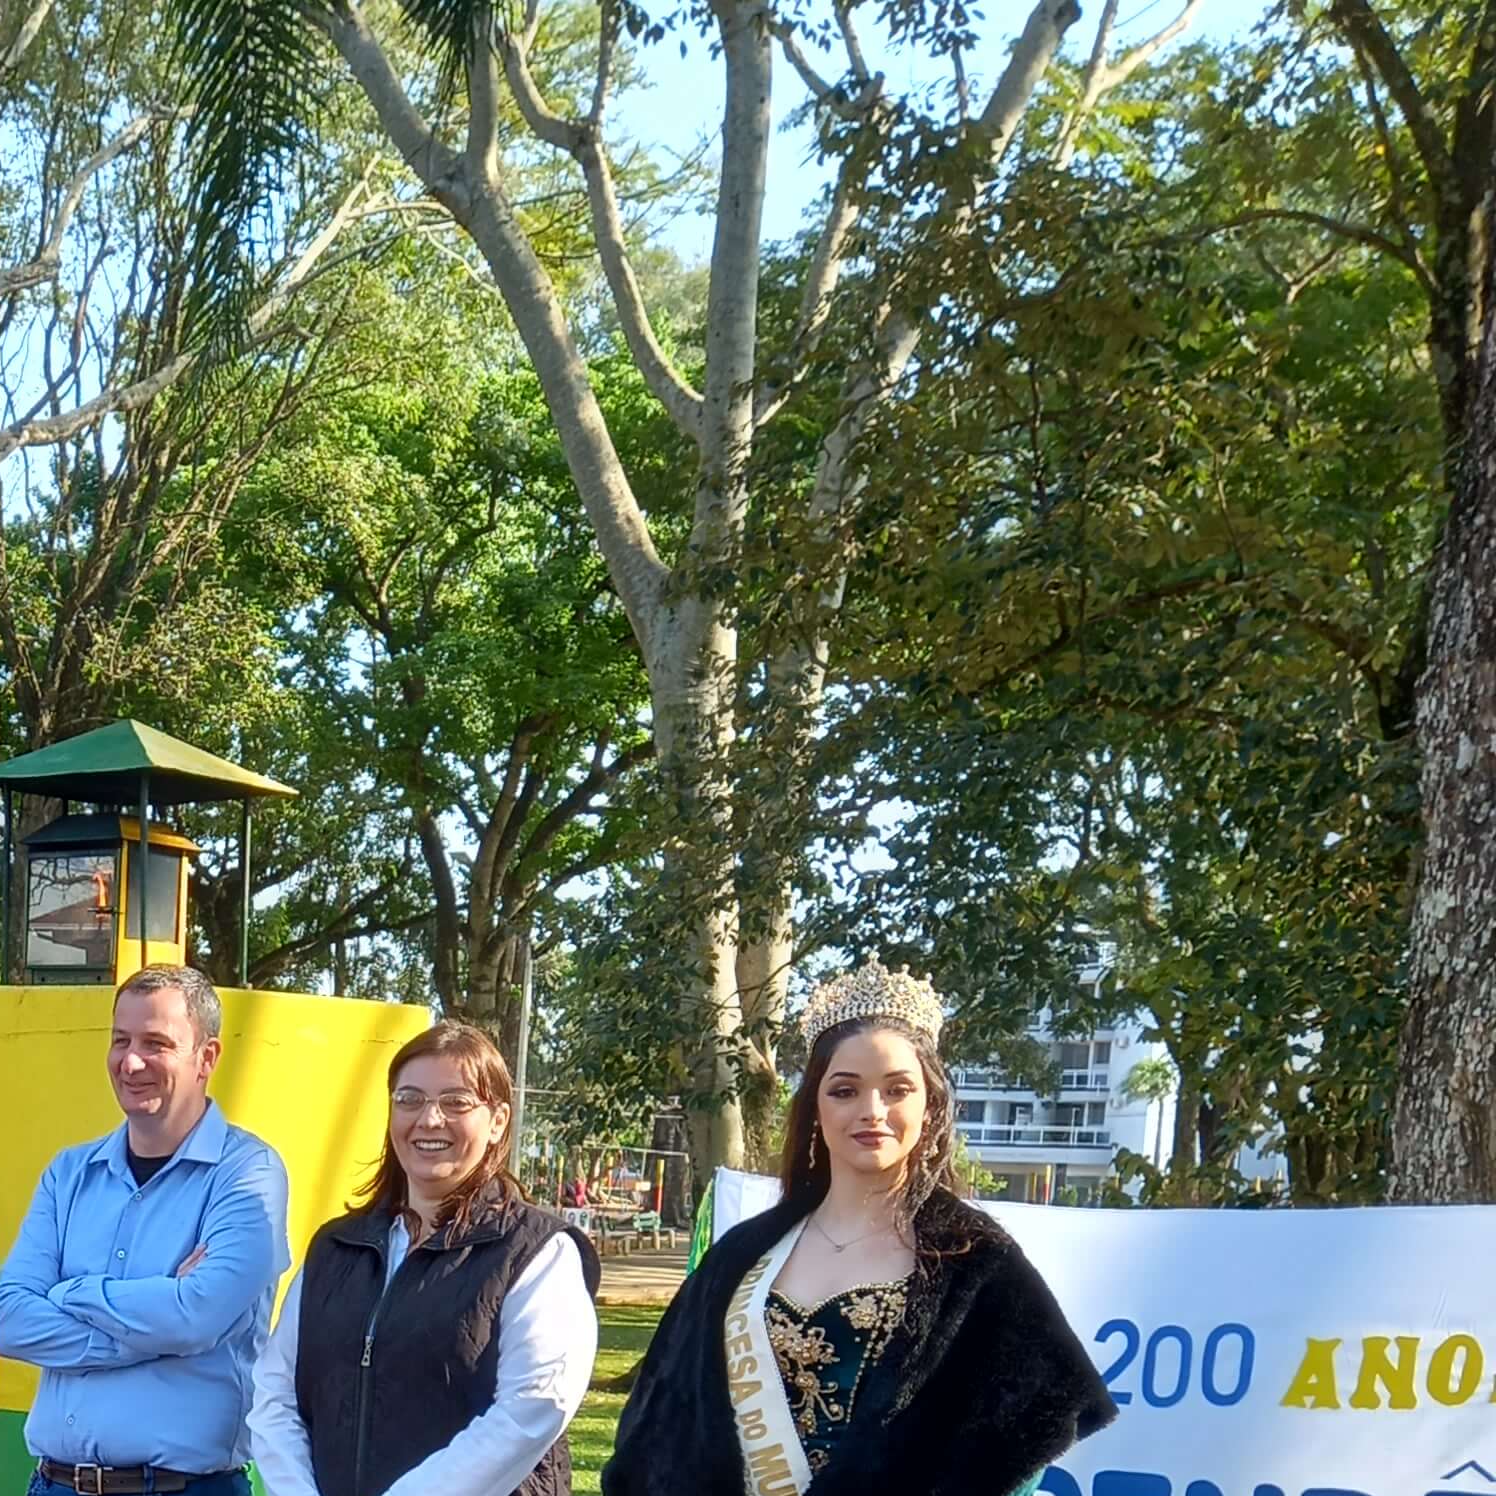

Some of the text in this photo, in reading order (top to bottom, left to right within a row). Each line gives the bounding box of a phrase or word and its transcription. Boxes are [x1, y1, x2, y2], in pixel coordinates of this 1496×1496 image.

[1094, 1318, 1496, 1410] 200 ANO
[740, 1408, 768, 1441] DO
